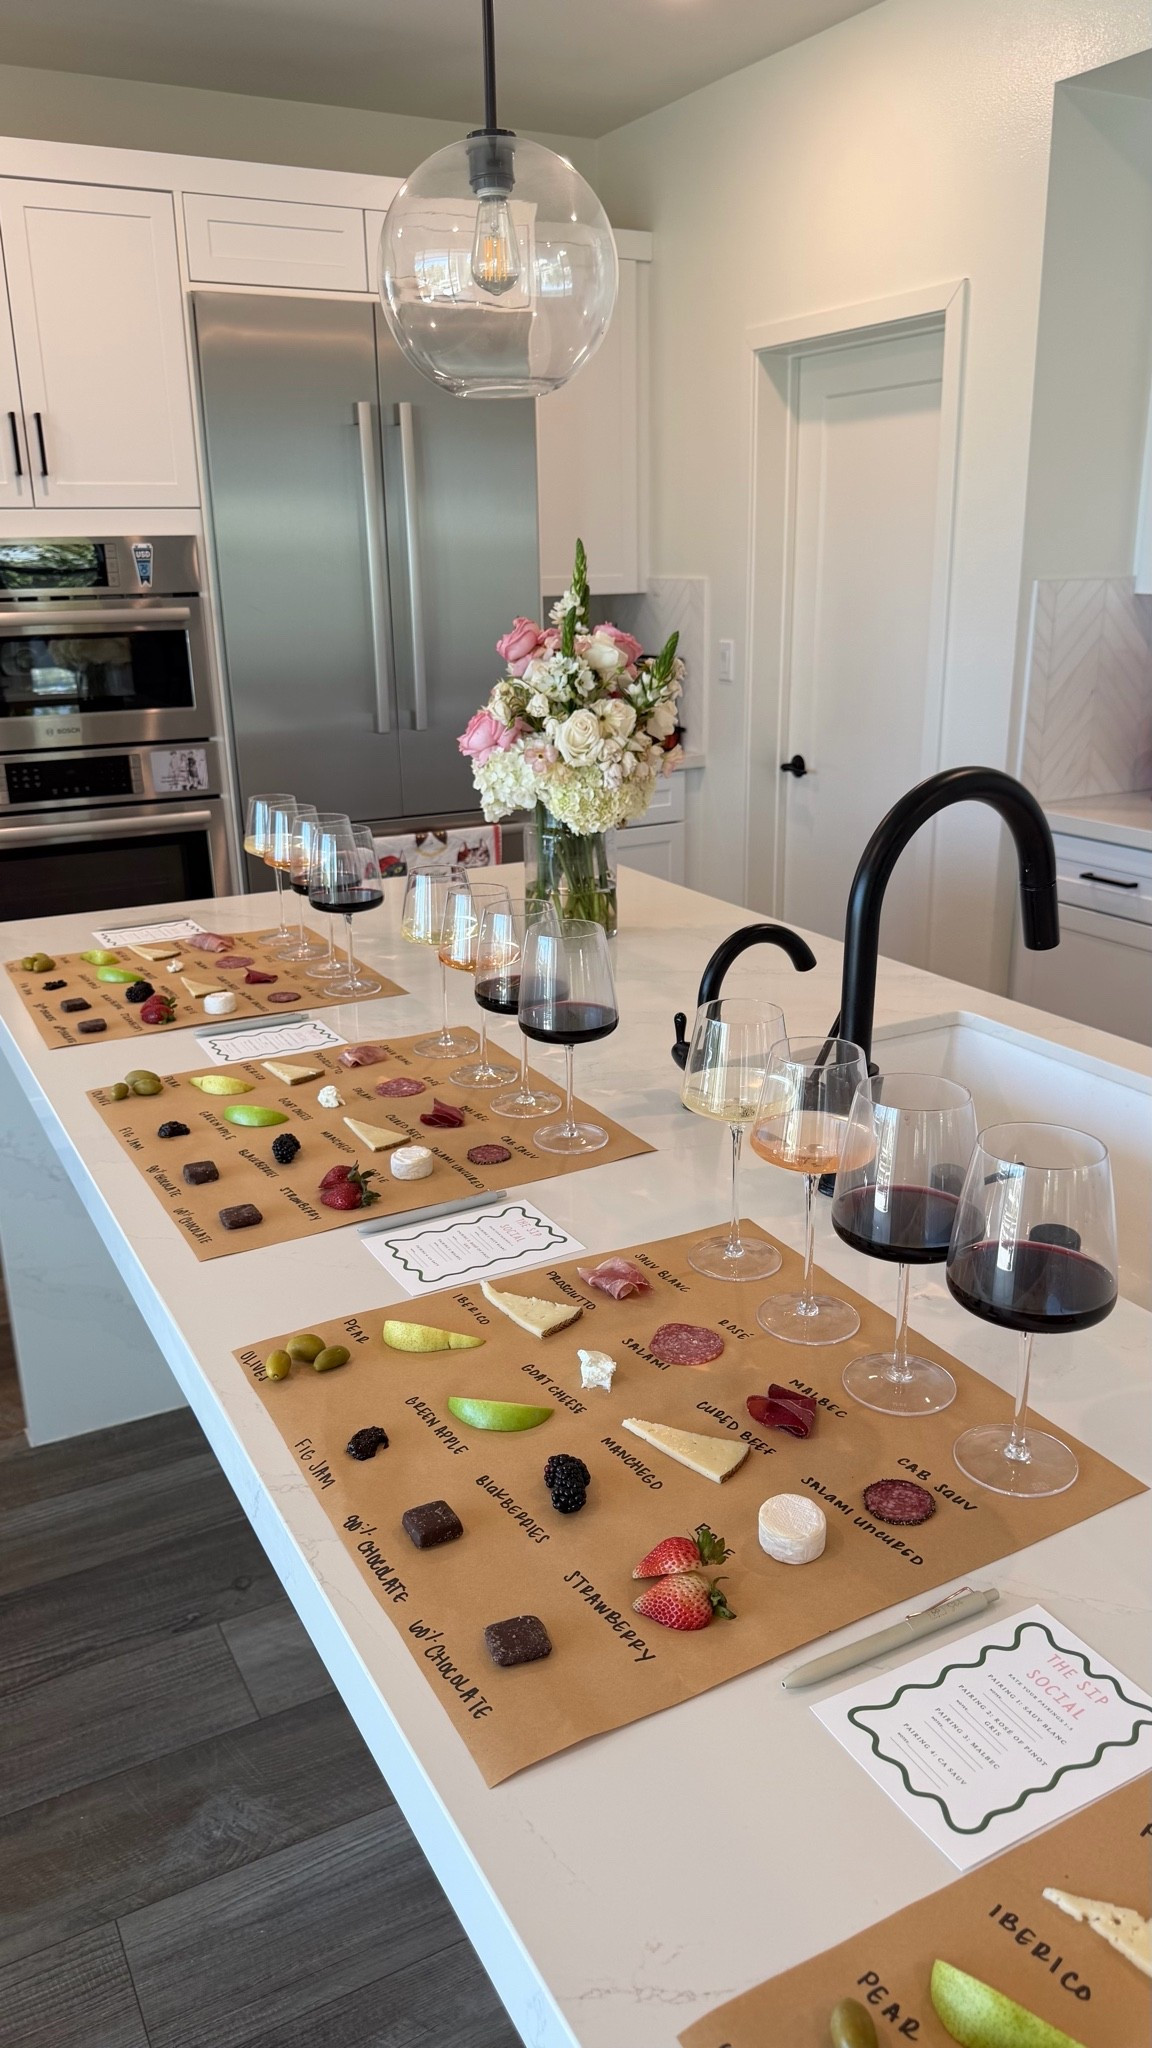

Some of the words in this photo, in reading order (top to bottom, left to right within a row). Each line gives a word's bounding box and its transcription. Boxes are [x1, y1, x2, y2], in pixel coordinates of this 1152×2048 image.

[118, 1126, 132, 1139] FIG
[546, 1270, 597, 1311] PROSCIUTTO
[634, 1253, 659, 1272] SAUV
[657, 1270, 692, 1293] BLANC
[344, 1318, 371, 1345] PEAR
[452, 1293, 490, 1326] IBERICO
[621, 1337, 672, 1371] SALAMI
[521, 1363, 554, 1387] GOAT
[547, 1384, 588, 1415] CHEESE
[788, 1378, 848, 1419] MALBEC
[404, 1396, 440, 1429] GREEN
[433, 1420, 470, 1455] APPLE
[695, 1401, 740, 1432] CURED
[739, 1430, 777, 1457] BEEF
[294, 1437, 313, 1461] FIG
[308, 1459, 337, 1490] JAM
[600, 1436, 663, 1491] MANCHEGO
[896, 1457, 932, 1482] CAB
[357, 1540, 409, 1603] CHOCOLATE
[563, 1570, 657, 1663] STRAWBERRY
[424, 1643, 494, 1720] CHOCOLATE
[1008, 1673, 1023, 1687] RATE
[1022, 1685, 1038, 1701] YOUR
[1037, 1699, 1065, 1723] PAIRINGS
[1026, 1669, 1086, 1721] SOCIAL
[1046, 1653, 1078, 1680] THE
[1076, 1680, 1109, 1706] SIP
[958, 1684, 987, 1711] PAIRING
[1013, 1735, 1025, 1745] OF
[1024, 1745, 1048, 1767] PINOT
[984, 1720, 1002, 1737] GRIS
[987, 1673, 1016, 1700] PAIRING
[1022, 1706, 1043, 1724] SAUV
[1042, 1723, 1068, 1745] BLANC
[903, 1723, 931, 1750] PAIRING
[937, 1757, 948, 1768] CA
[947, 1768, 967, 1785] SAUV
[935, 1707, 963, 1734] PAIRING
[970, 1742, 1000, 1770] MALBEC
[988, 1903, 1092, 2002] IBERICO
[857, 1970, 922, 2042] PEAR
